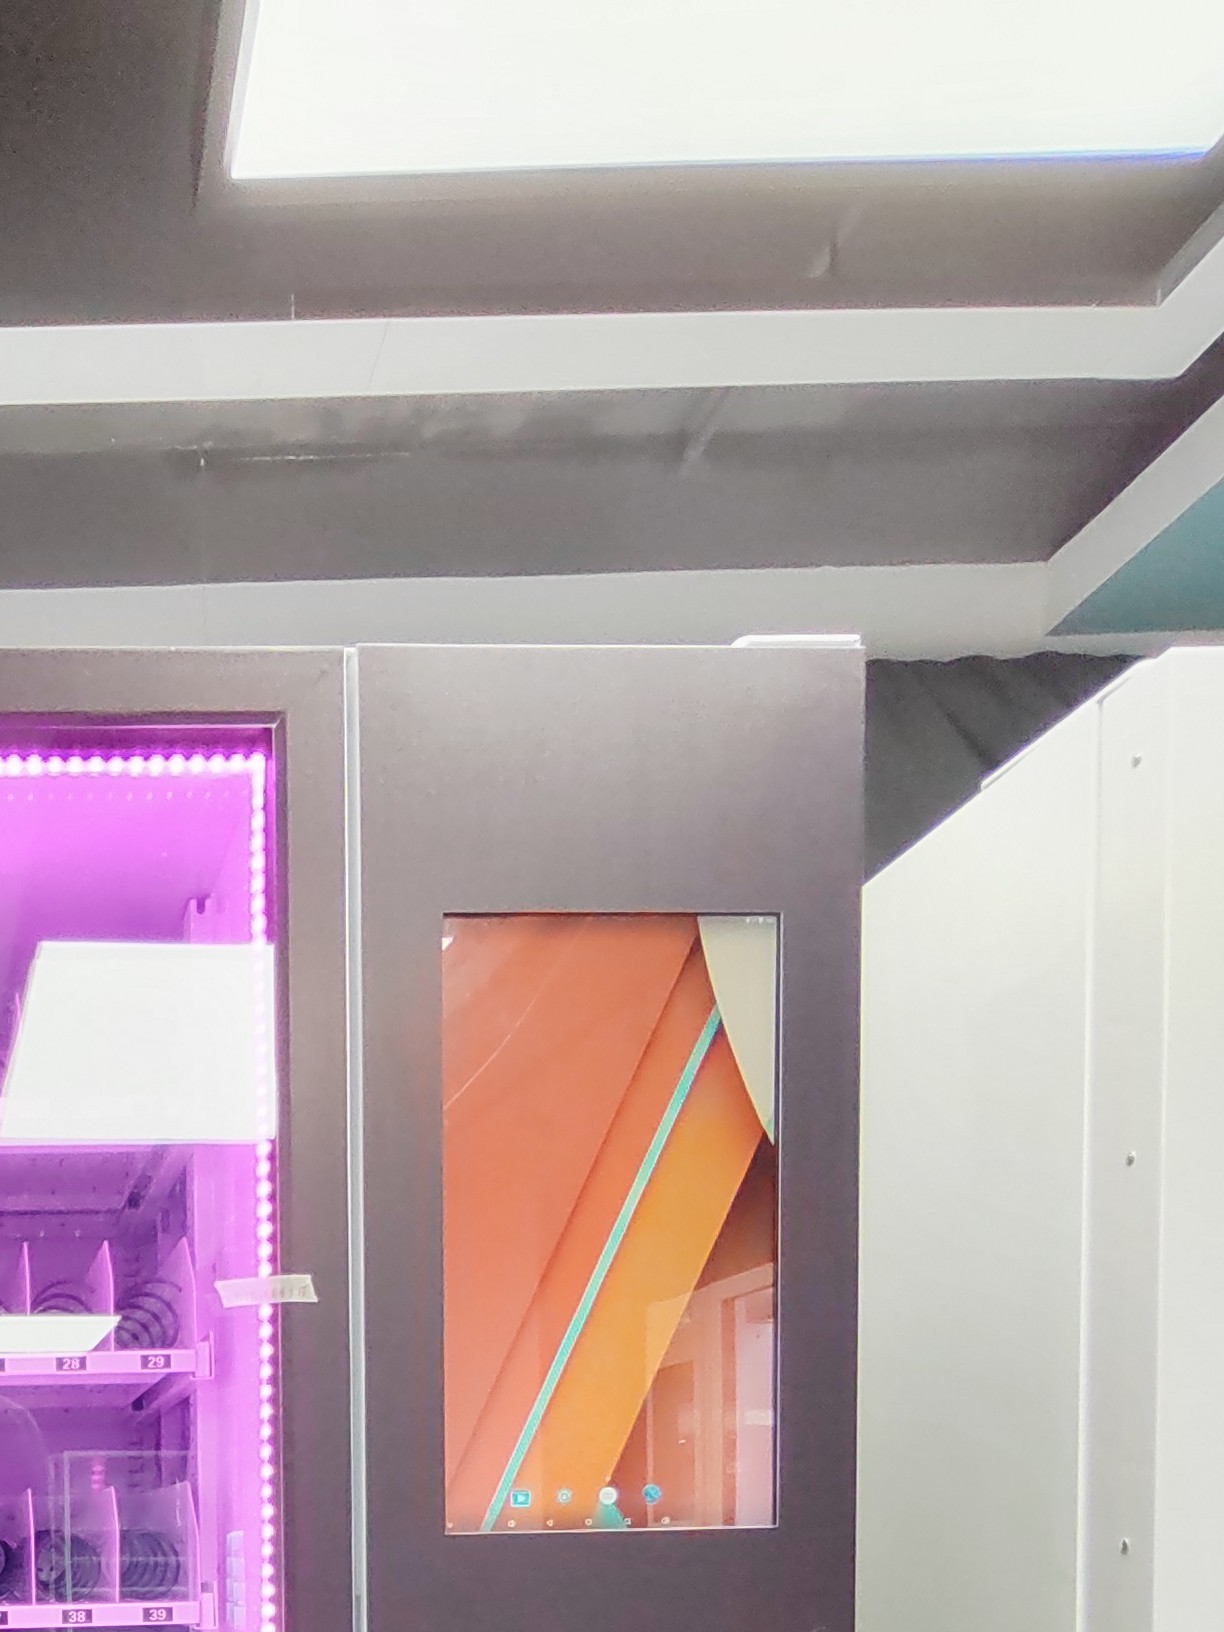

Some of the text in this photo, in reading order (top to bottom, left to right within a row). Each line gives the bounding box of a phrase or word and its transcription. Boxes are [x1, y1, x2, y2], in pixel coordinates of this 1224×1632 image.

[62, 1357, 80, 1370] 28
[148, 1355, 165, 1368] 29
[68, 1611, 86, 1623] 38
[149, 1609, 166, 1620] 39
